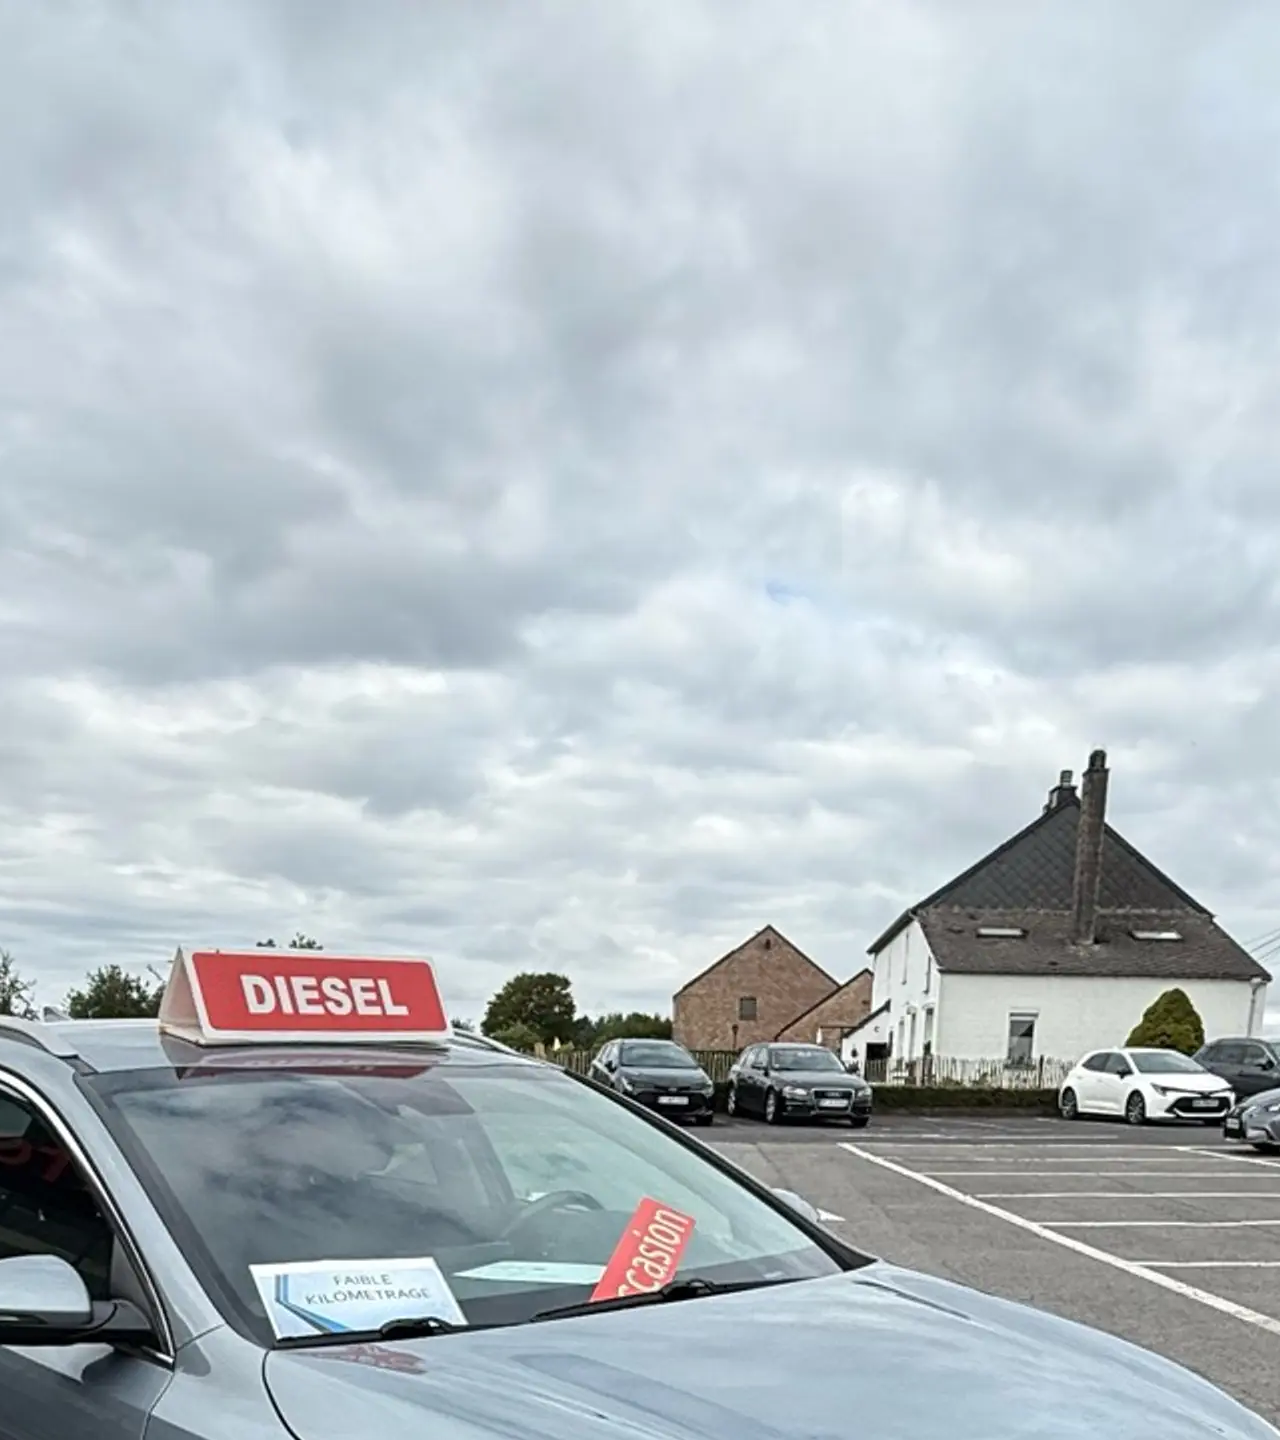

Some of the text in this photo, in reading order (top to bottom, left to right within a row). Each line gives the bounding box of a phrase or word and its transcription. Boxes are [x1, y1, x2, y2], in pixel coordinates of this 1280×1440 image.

[240, 974, 408, 1016] DIESEL
[333, 1274, 393, 1286] FAIBLE
[305, 1288, 431, 1305] KILOMETRAGE
